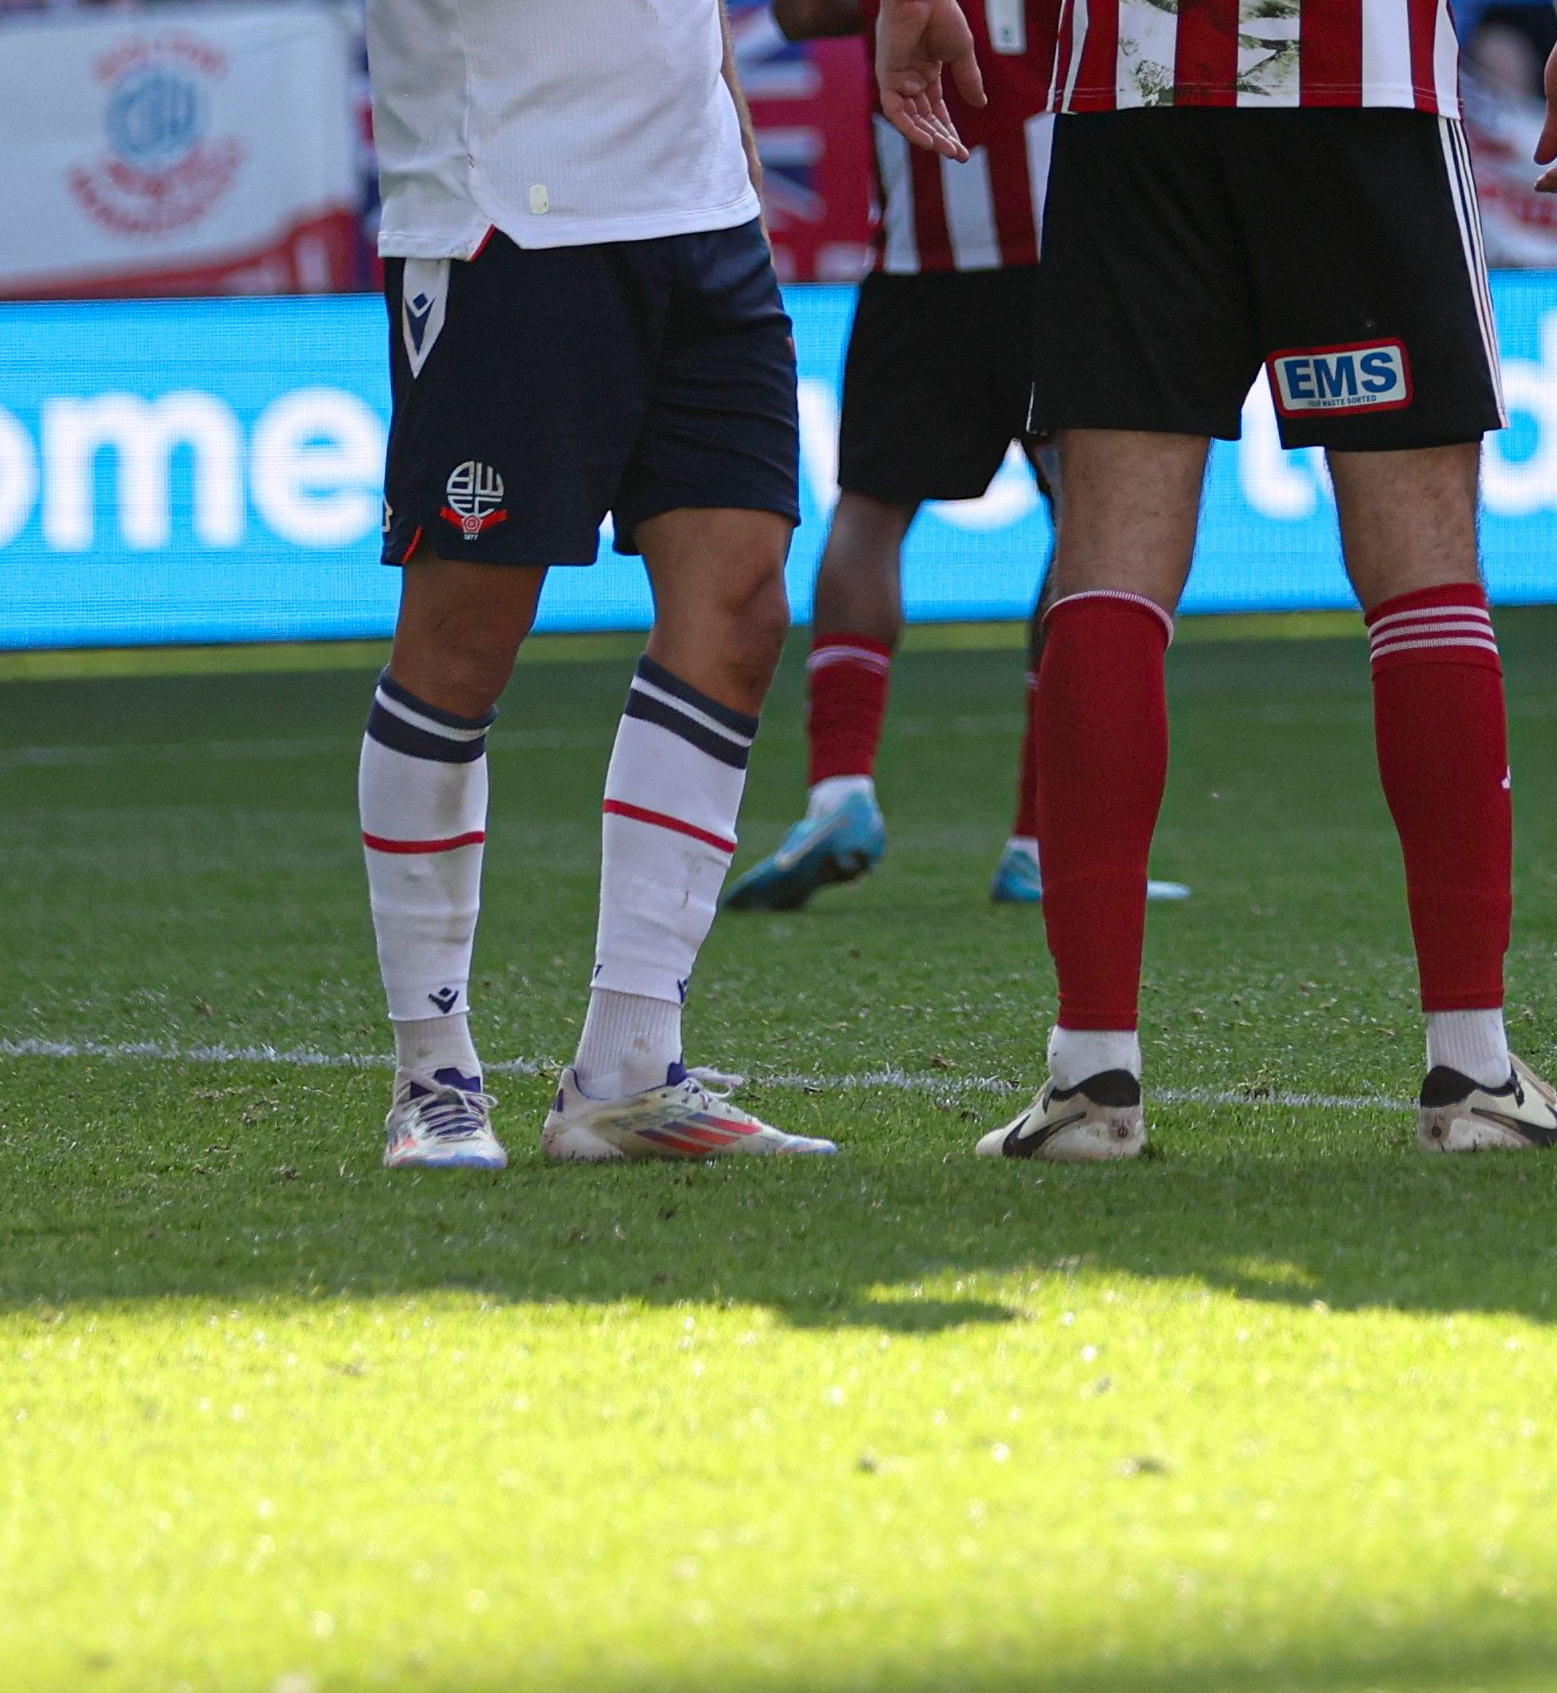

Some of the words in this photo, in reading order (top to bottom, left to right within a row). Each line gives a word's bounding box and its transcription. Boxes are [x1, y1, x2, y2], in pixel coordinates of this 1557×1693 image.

[1283, 351, 1398, 400] EMS
[1322, 399, 1345, 407] WASTE
[1346, 394, 1377, 406] SORTED
